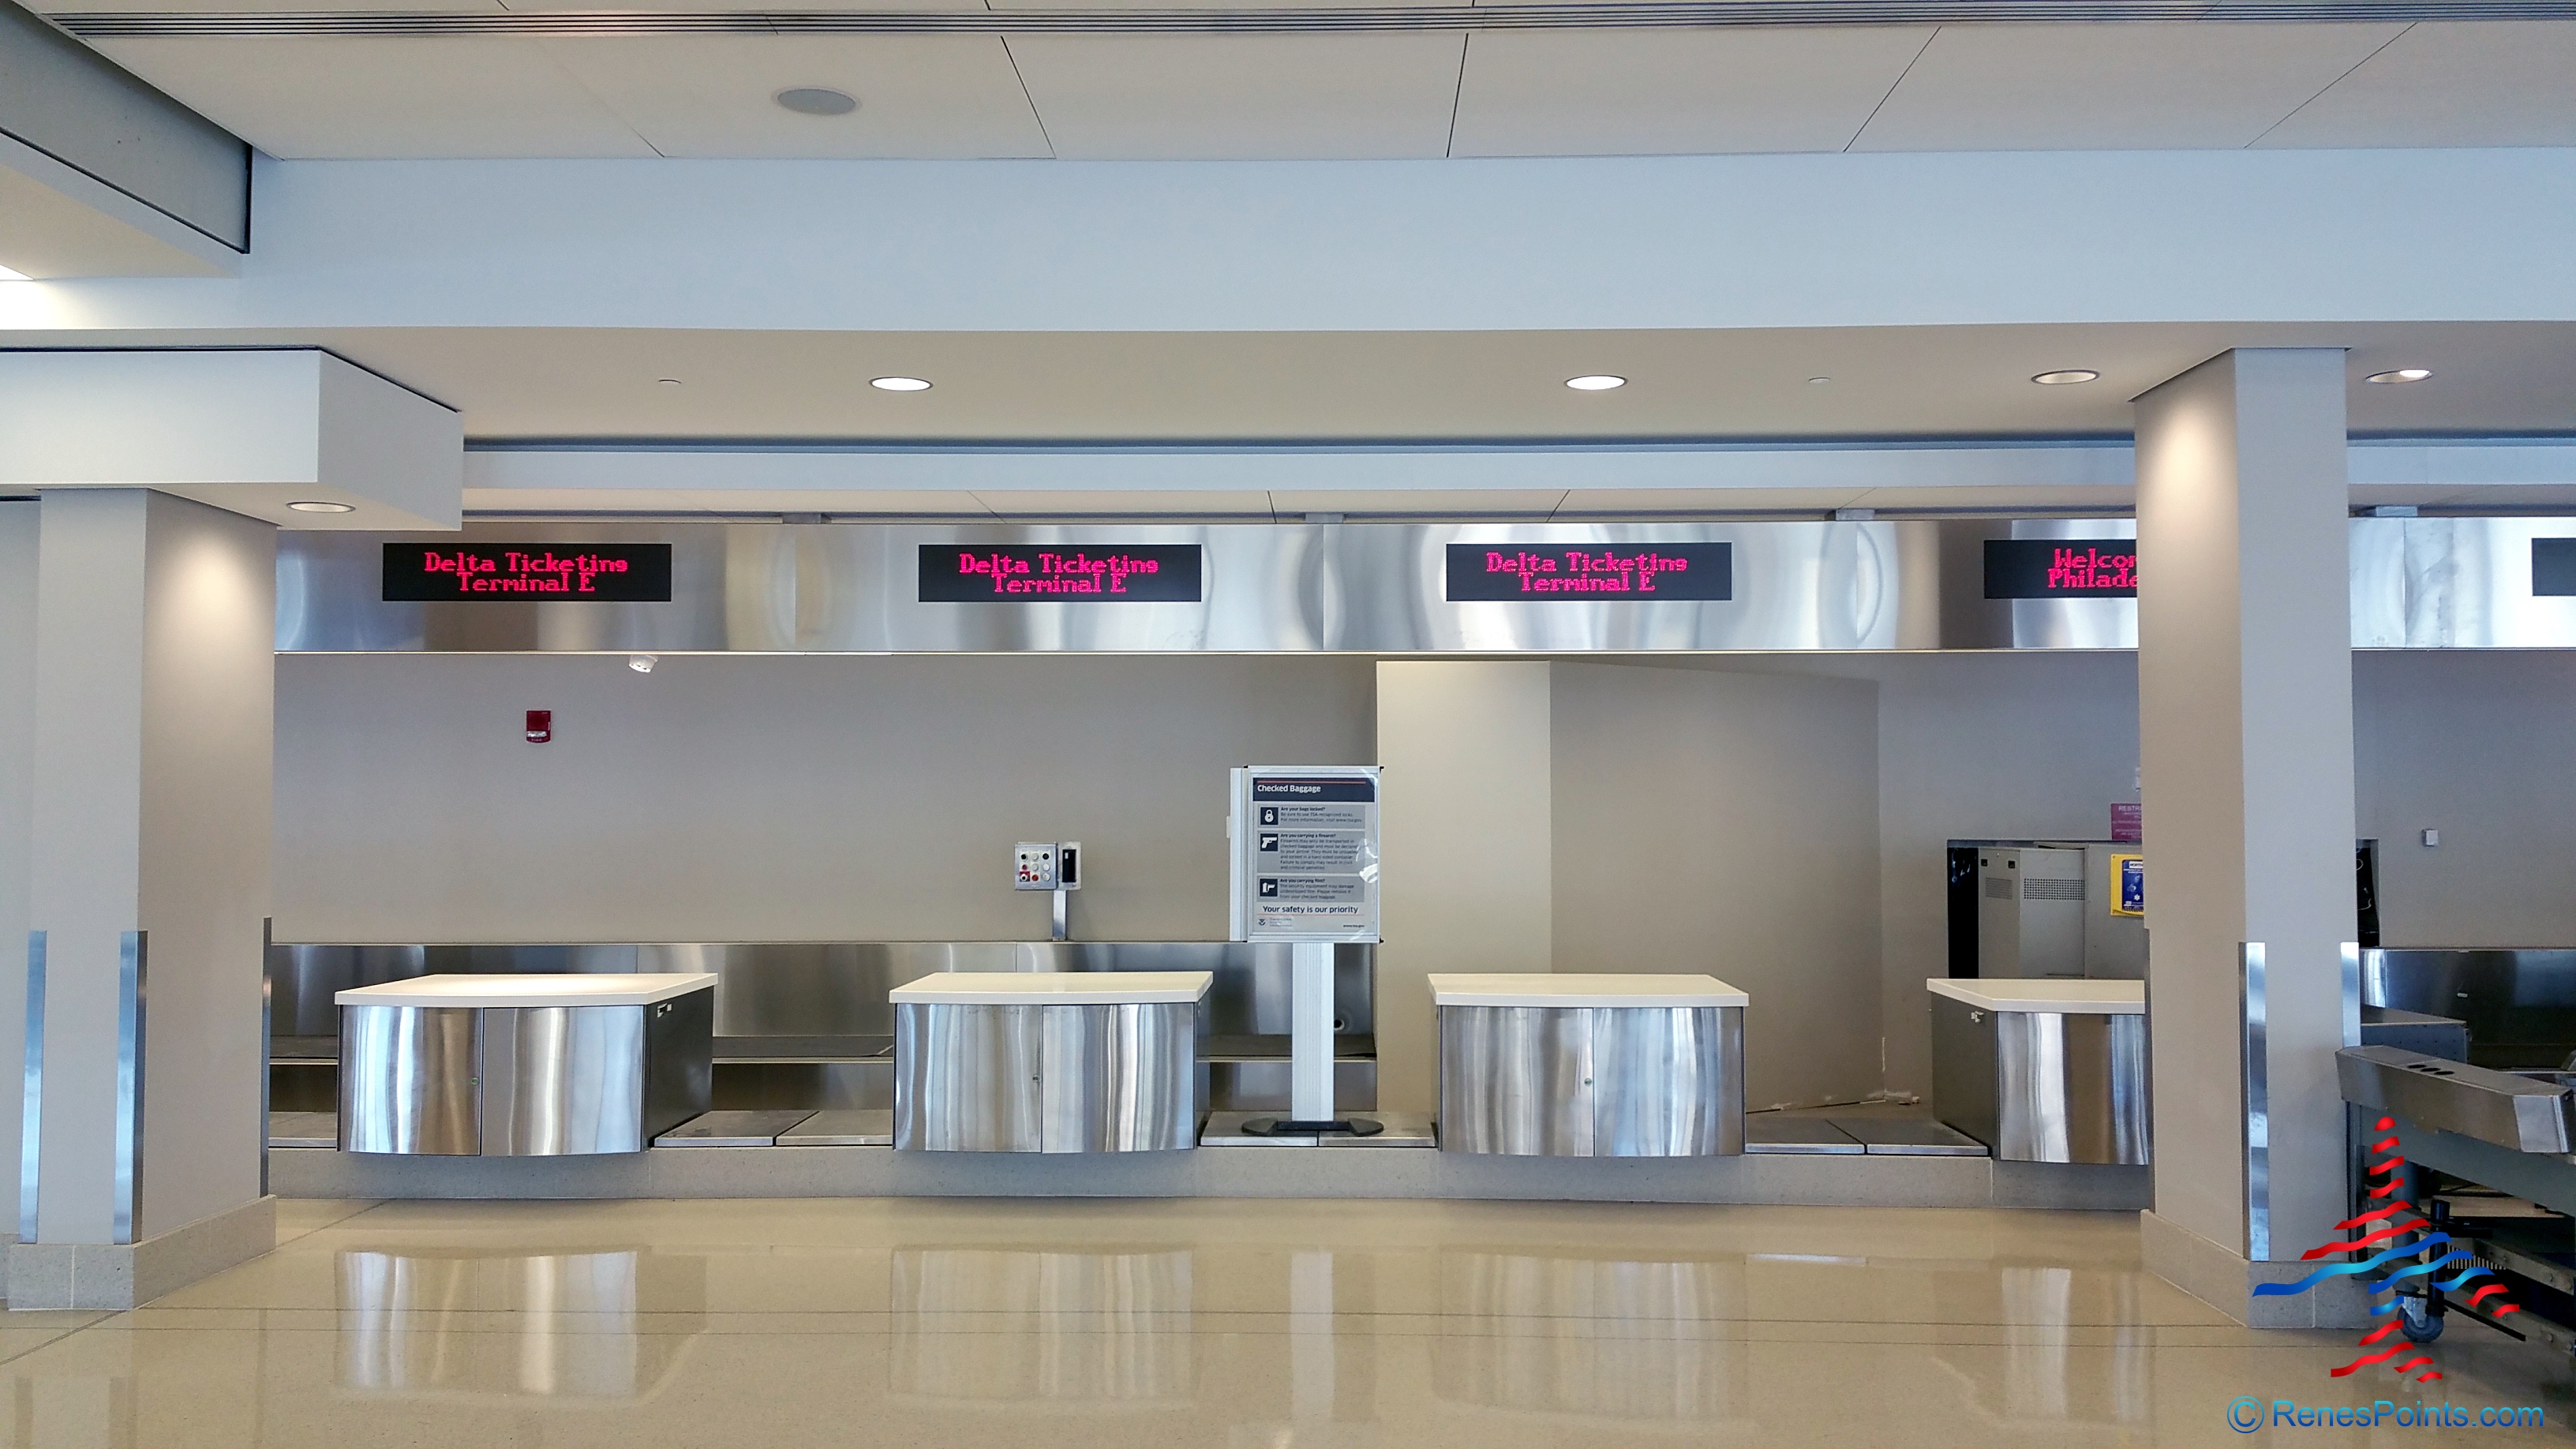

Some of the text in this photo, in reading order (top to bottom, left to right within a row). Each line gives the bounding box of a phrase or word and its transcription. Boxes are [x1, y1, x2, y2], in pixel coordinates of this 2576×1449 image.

[424, 552, 628, 572] Delta Ticketing
[959, 553, 1159, 573] Delta Ticketing
[1486, 552, 1688, 572] Delta Ticketing
[456, 571, 596, 591] Terminal E
[991, 573, 1127, 593] Terminal E
[1518, 571, 1655, 591] Terminal E
[1290, 784, 1321, 794] Baggage
